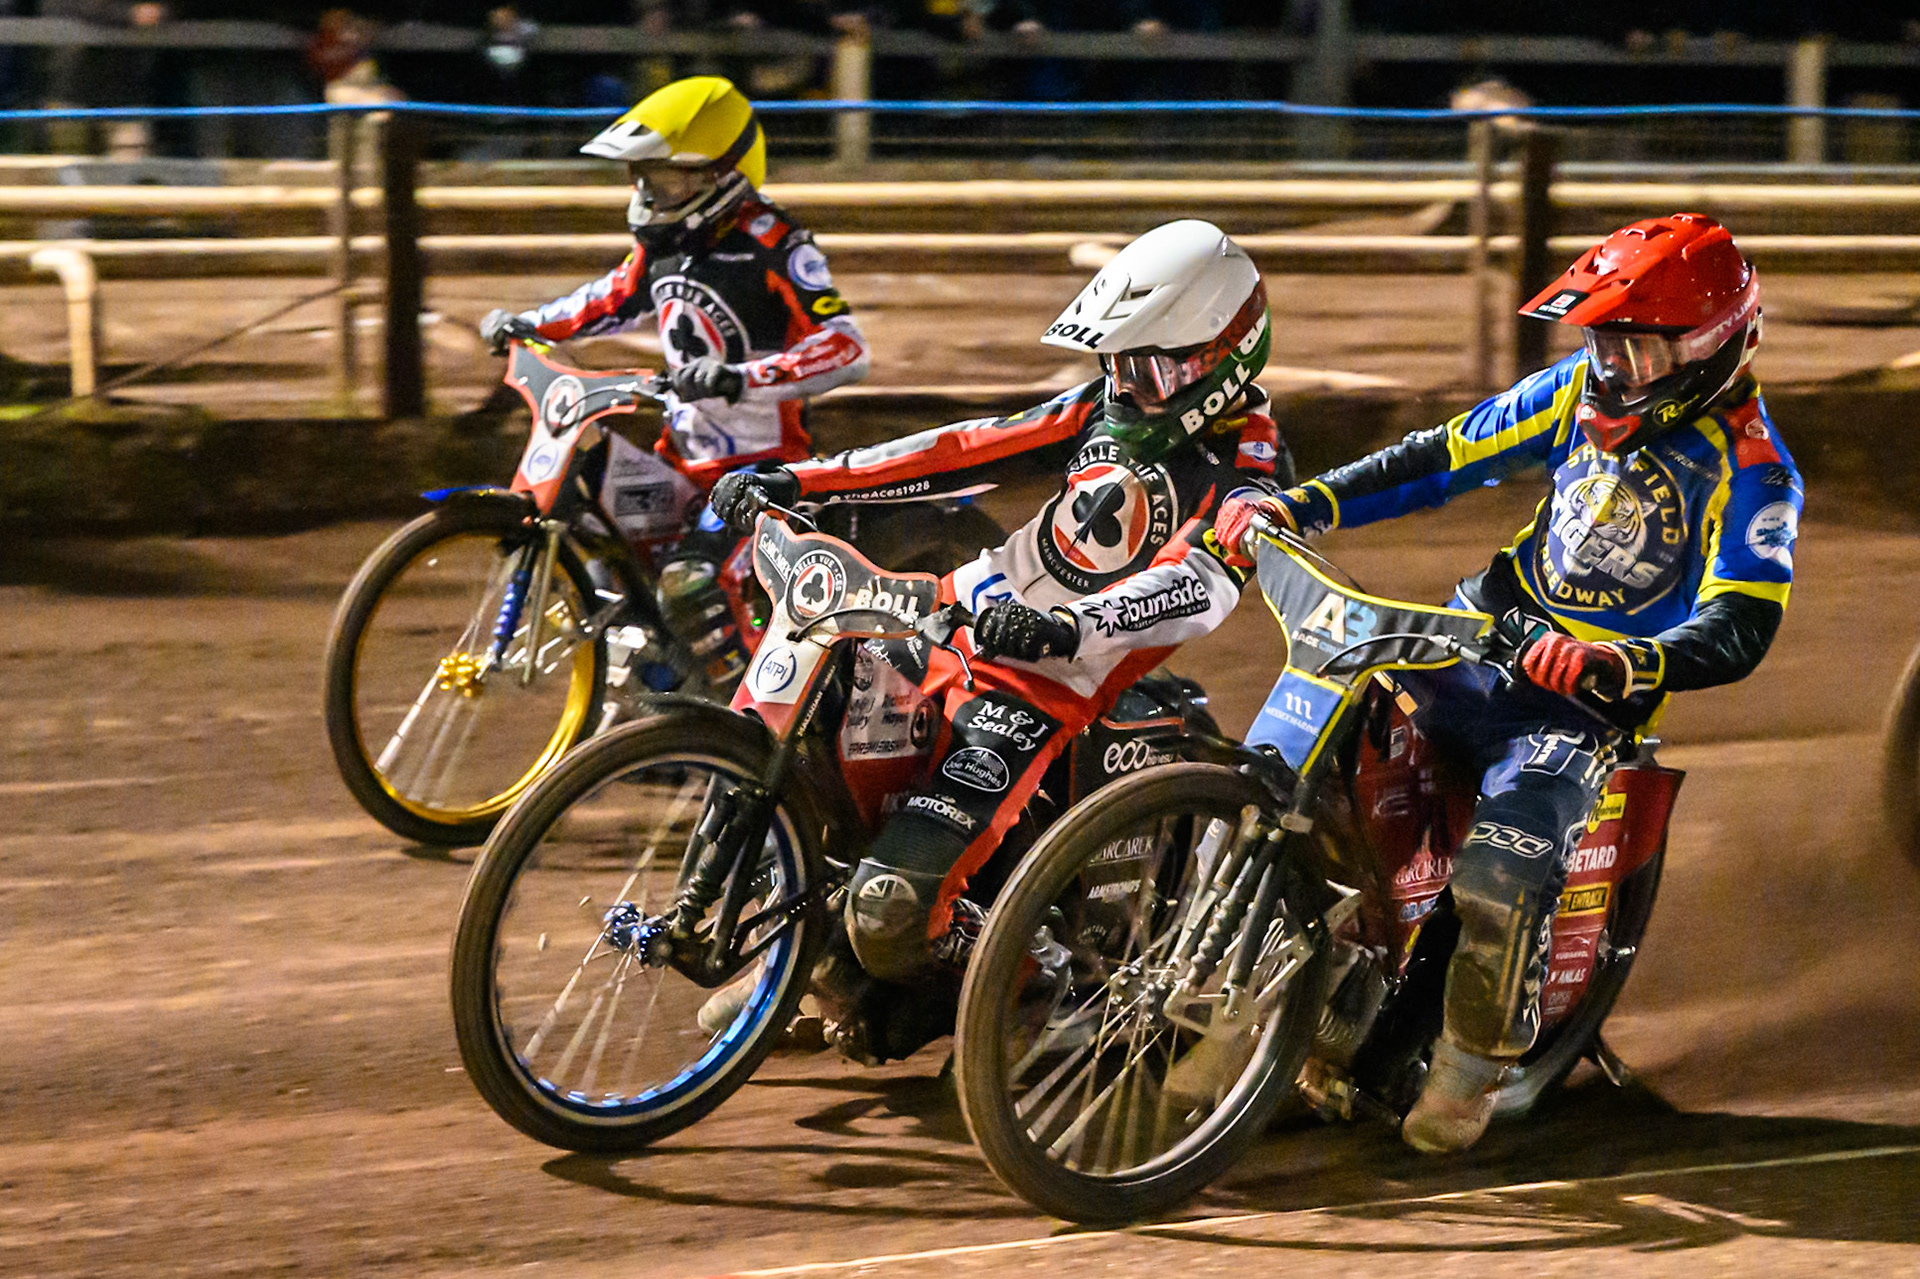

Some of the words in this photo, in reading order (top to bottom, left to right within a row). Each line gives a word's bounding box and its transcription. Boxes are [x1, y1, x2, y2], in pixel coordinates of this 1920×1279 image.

[1044, 322, 1105, 350] BOLL
[1179, 362, 1251, 436] BOLL
[1151, 494, 1169, 547] ACES
[1541, 540, 1626, 607] PEEDWAY
[853, 588, 920, 618] BOLL
[1122, 577, 1208, 623] burnside
[763, 660, 789, 681] ATPI
[967, 715, 1037, 752] Sealey
[977, 700, 1008, 719] M
[1009, 710, 1034, 726] &
[1029, 723, 1049, 738] J
[964, 762, 1002, 788] Hughes
[907, 796, 977, 830] MOTOREX
[1568, 845, 1618, 873] BETARD
